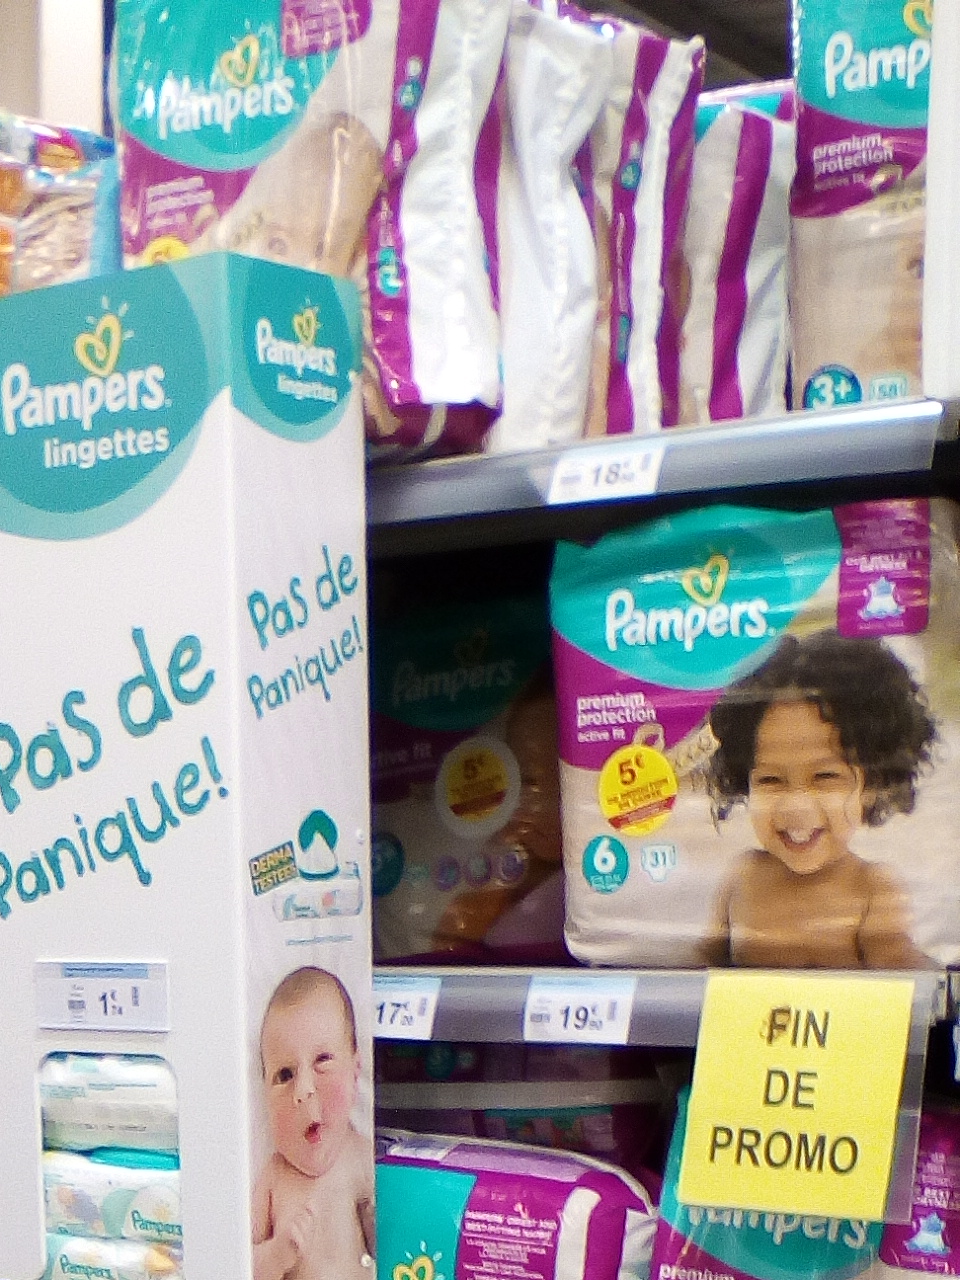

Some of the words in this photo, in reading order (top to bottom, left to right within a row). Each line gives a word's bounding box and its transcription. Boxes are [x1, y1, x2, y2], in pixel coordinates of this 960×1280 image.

[157, 76, 295, 139] Pampers
[256, 318, 337, 377] Pampers
[1, 363, 166, 436] Pampers
[44, 427, 170, 469] lingettes
[246, 576, 310, 650] Pas
[315, 545, 359, 612] de
[605, 589, 769, 652] Pampers
[117, 626, 216, 738] de
[247, 615, 365, 718] Panique!
[577, 692, 646, 712] premium
[577, 707, 656, 728] protection
[593, 838, 616, 874] 6
[765, 1006, 830, 1048] FIN
[763, 1069, 818, 1111] DE
[709, 1126, 859, 1175] PROMO
